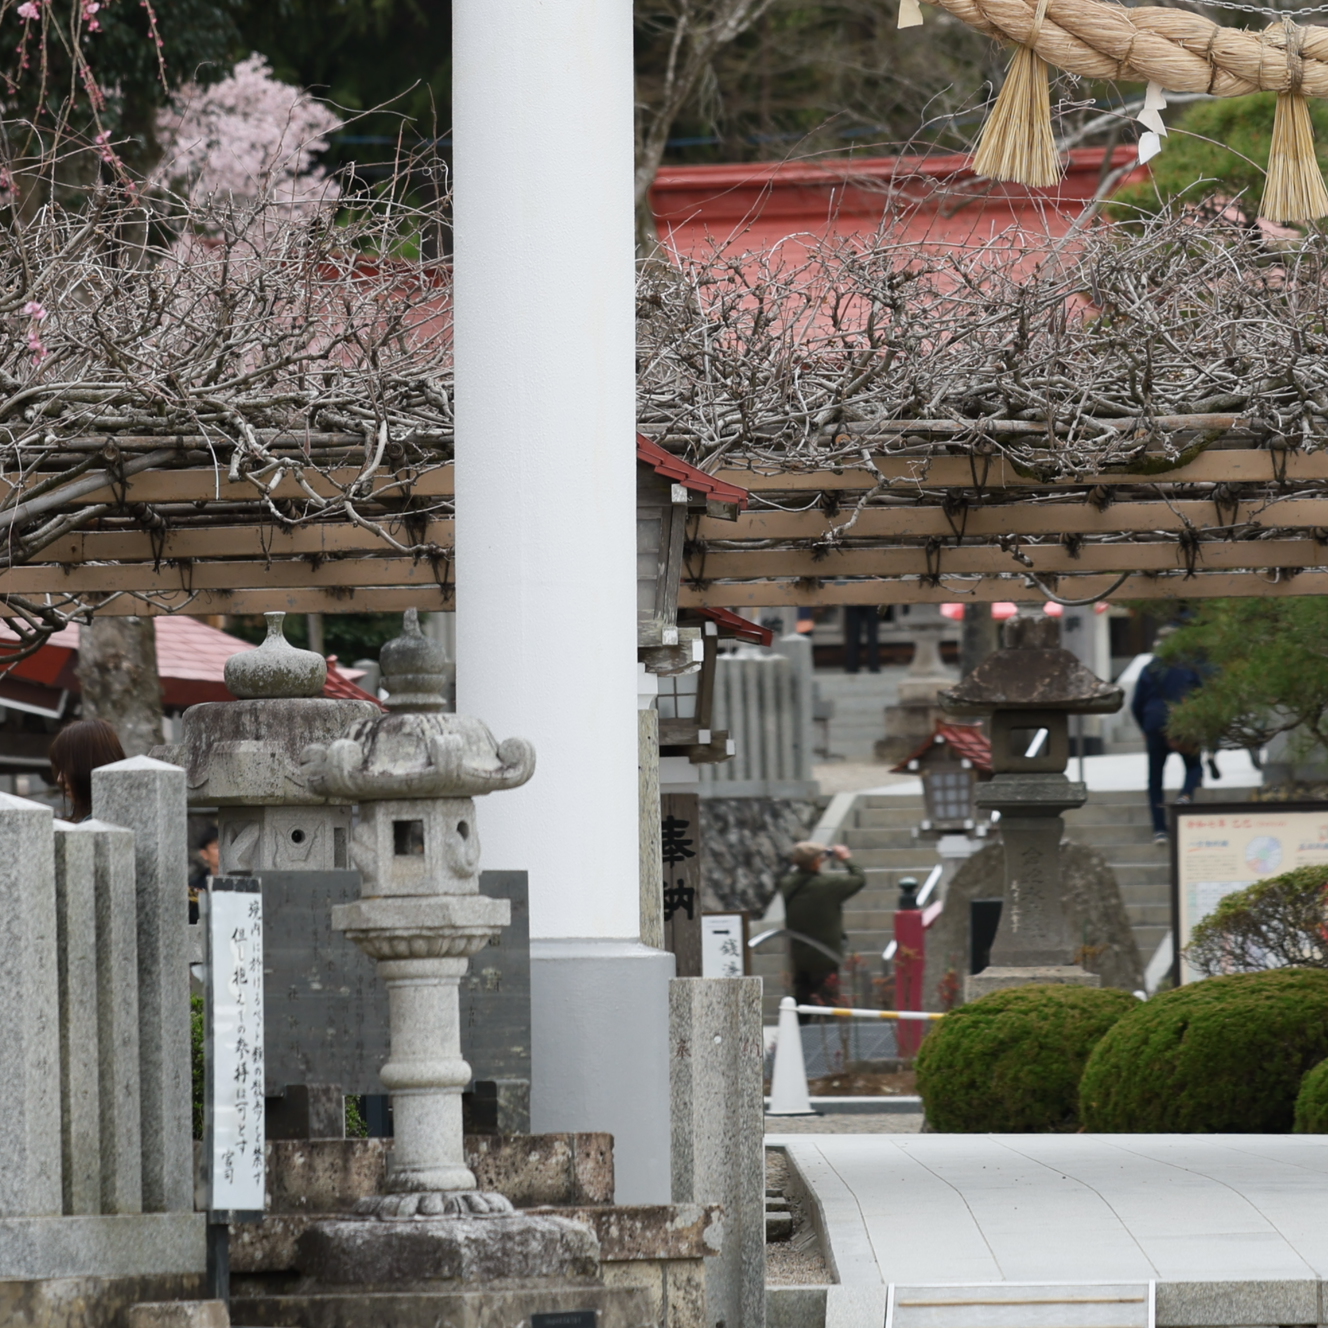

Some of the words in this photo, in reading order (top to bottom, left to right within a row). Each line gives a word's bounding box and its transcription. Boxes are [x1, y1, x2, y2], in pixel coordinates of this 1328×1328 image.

[231, 927, 250, 1157] 但し抱えての参拝は可とす
[221, 1148, 235, 1185] 宮司
